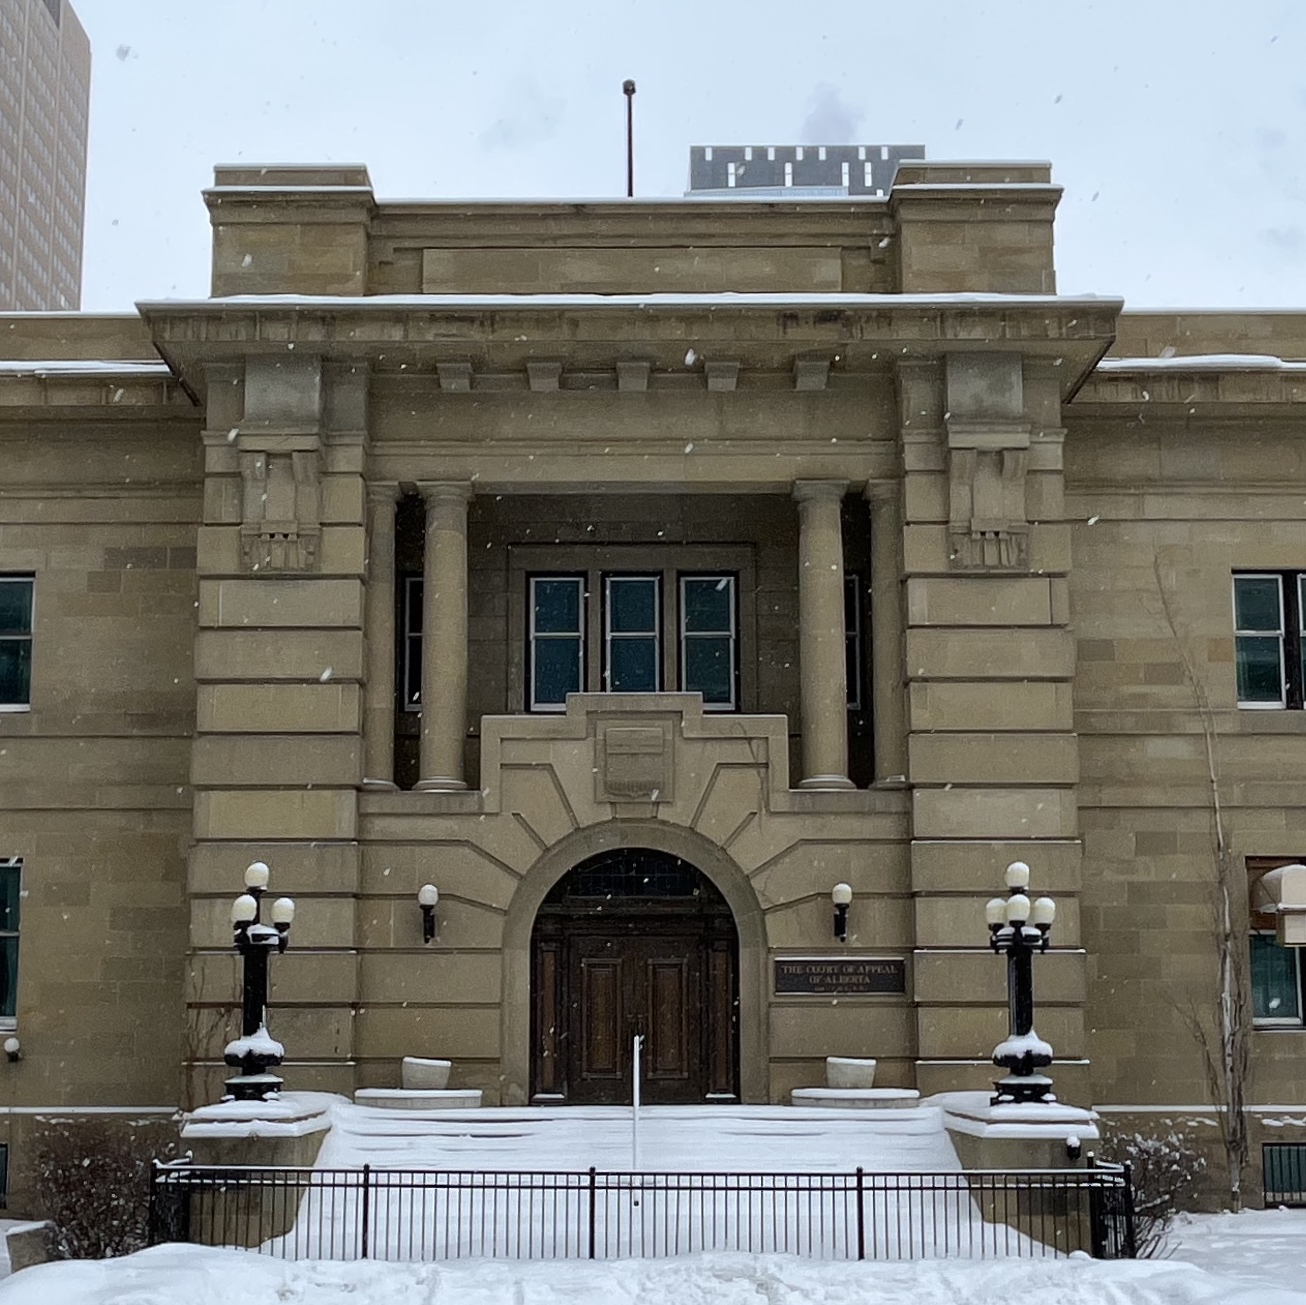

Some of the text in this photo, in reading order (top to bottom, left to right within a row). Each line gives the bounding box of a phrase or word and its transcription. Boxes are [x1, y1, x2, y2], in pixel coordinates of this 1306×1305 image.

[781, 965, 897, 974] THE COURT OF APPEAL
[809, 975, 870, 984] OF ALBERTA
